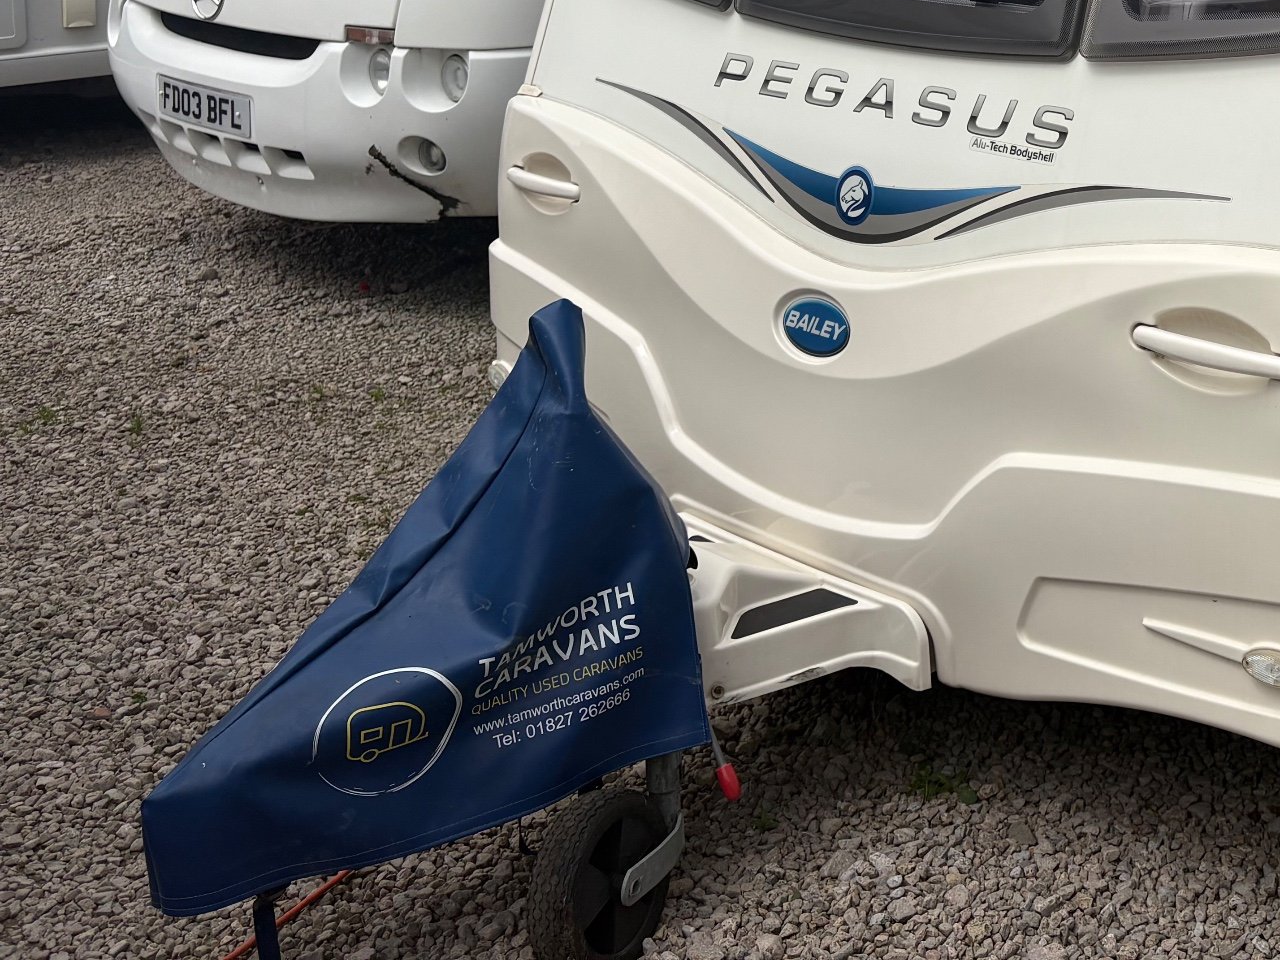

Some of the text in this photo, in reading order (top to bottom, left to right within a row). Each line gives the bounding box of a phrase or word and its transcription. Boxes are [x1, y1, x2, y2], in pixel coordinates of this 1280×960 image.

[163, 81, 242, 130] FD03 BFL
[713, 52, 1075, 149] PEGASUS
[971, 138, 1055, 163] Alu-Tech Bodyshell
[785, 309, 847, 341] BAILEY
[474, 613, 642, 700] CARAVANS
[478, 581, 636, 678] TAMWORTH
[471, 646, 644, 716] QUALITY USED CARAVANS
[473, 667, 646, 736] www.tamworthcaravans.com
[493, 687, 631, 749] Tel: 01827 262666
